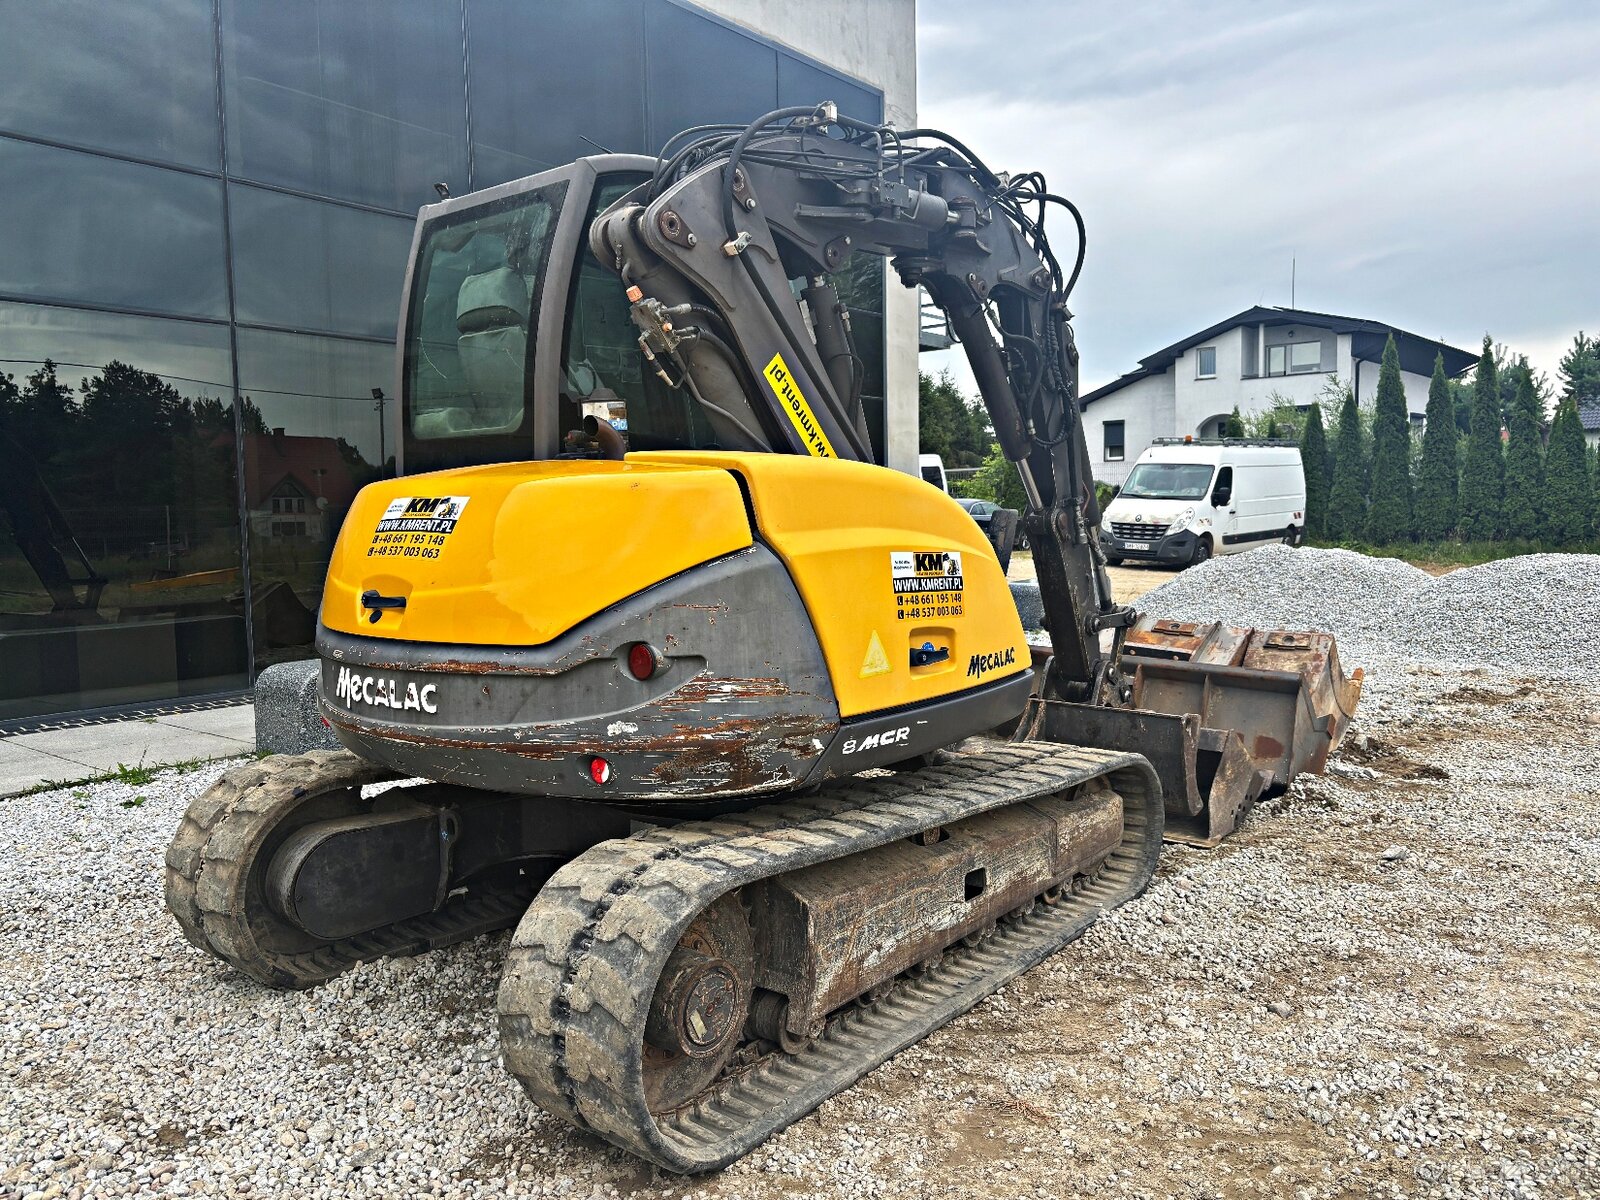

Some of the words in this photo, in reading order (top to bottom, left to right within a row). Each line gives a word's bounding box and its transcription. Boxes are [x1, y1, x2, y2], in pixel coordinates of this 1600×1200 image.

[405, 498, 441, 512] KM
[376, 520, 453, 532] WWW.KMRENT.PL
[378, 535, 393, 544] +48
[393, 534, 408, 544] 661
[409, 534, 426, 544] 195
[427, 535, 445, 546] 148
[373, 546, 387, 556] +48
[387, 546, 404, 556] 537
[403, 547, 420, 557] 003
[421, 548, 440, 559] 063
[915, 553, 943, 571] KM
[893, 578, 963, 591] WWW.KMRENT.PL
[904, 595, 920, 606] +48
[921, 594, 934, 605] 661
[936, 593, 949, 604] 195
[950, 592, 962, 603] 148
[905, 608, 920, 619] +48
[921, 607, 936, 618] 537
[936, 606, 949, 617] 003
[950, 605, 963, 616] 063
[841, 739, 857, 755] 8
[857, 726, 911, 752] MCR
